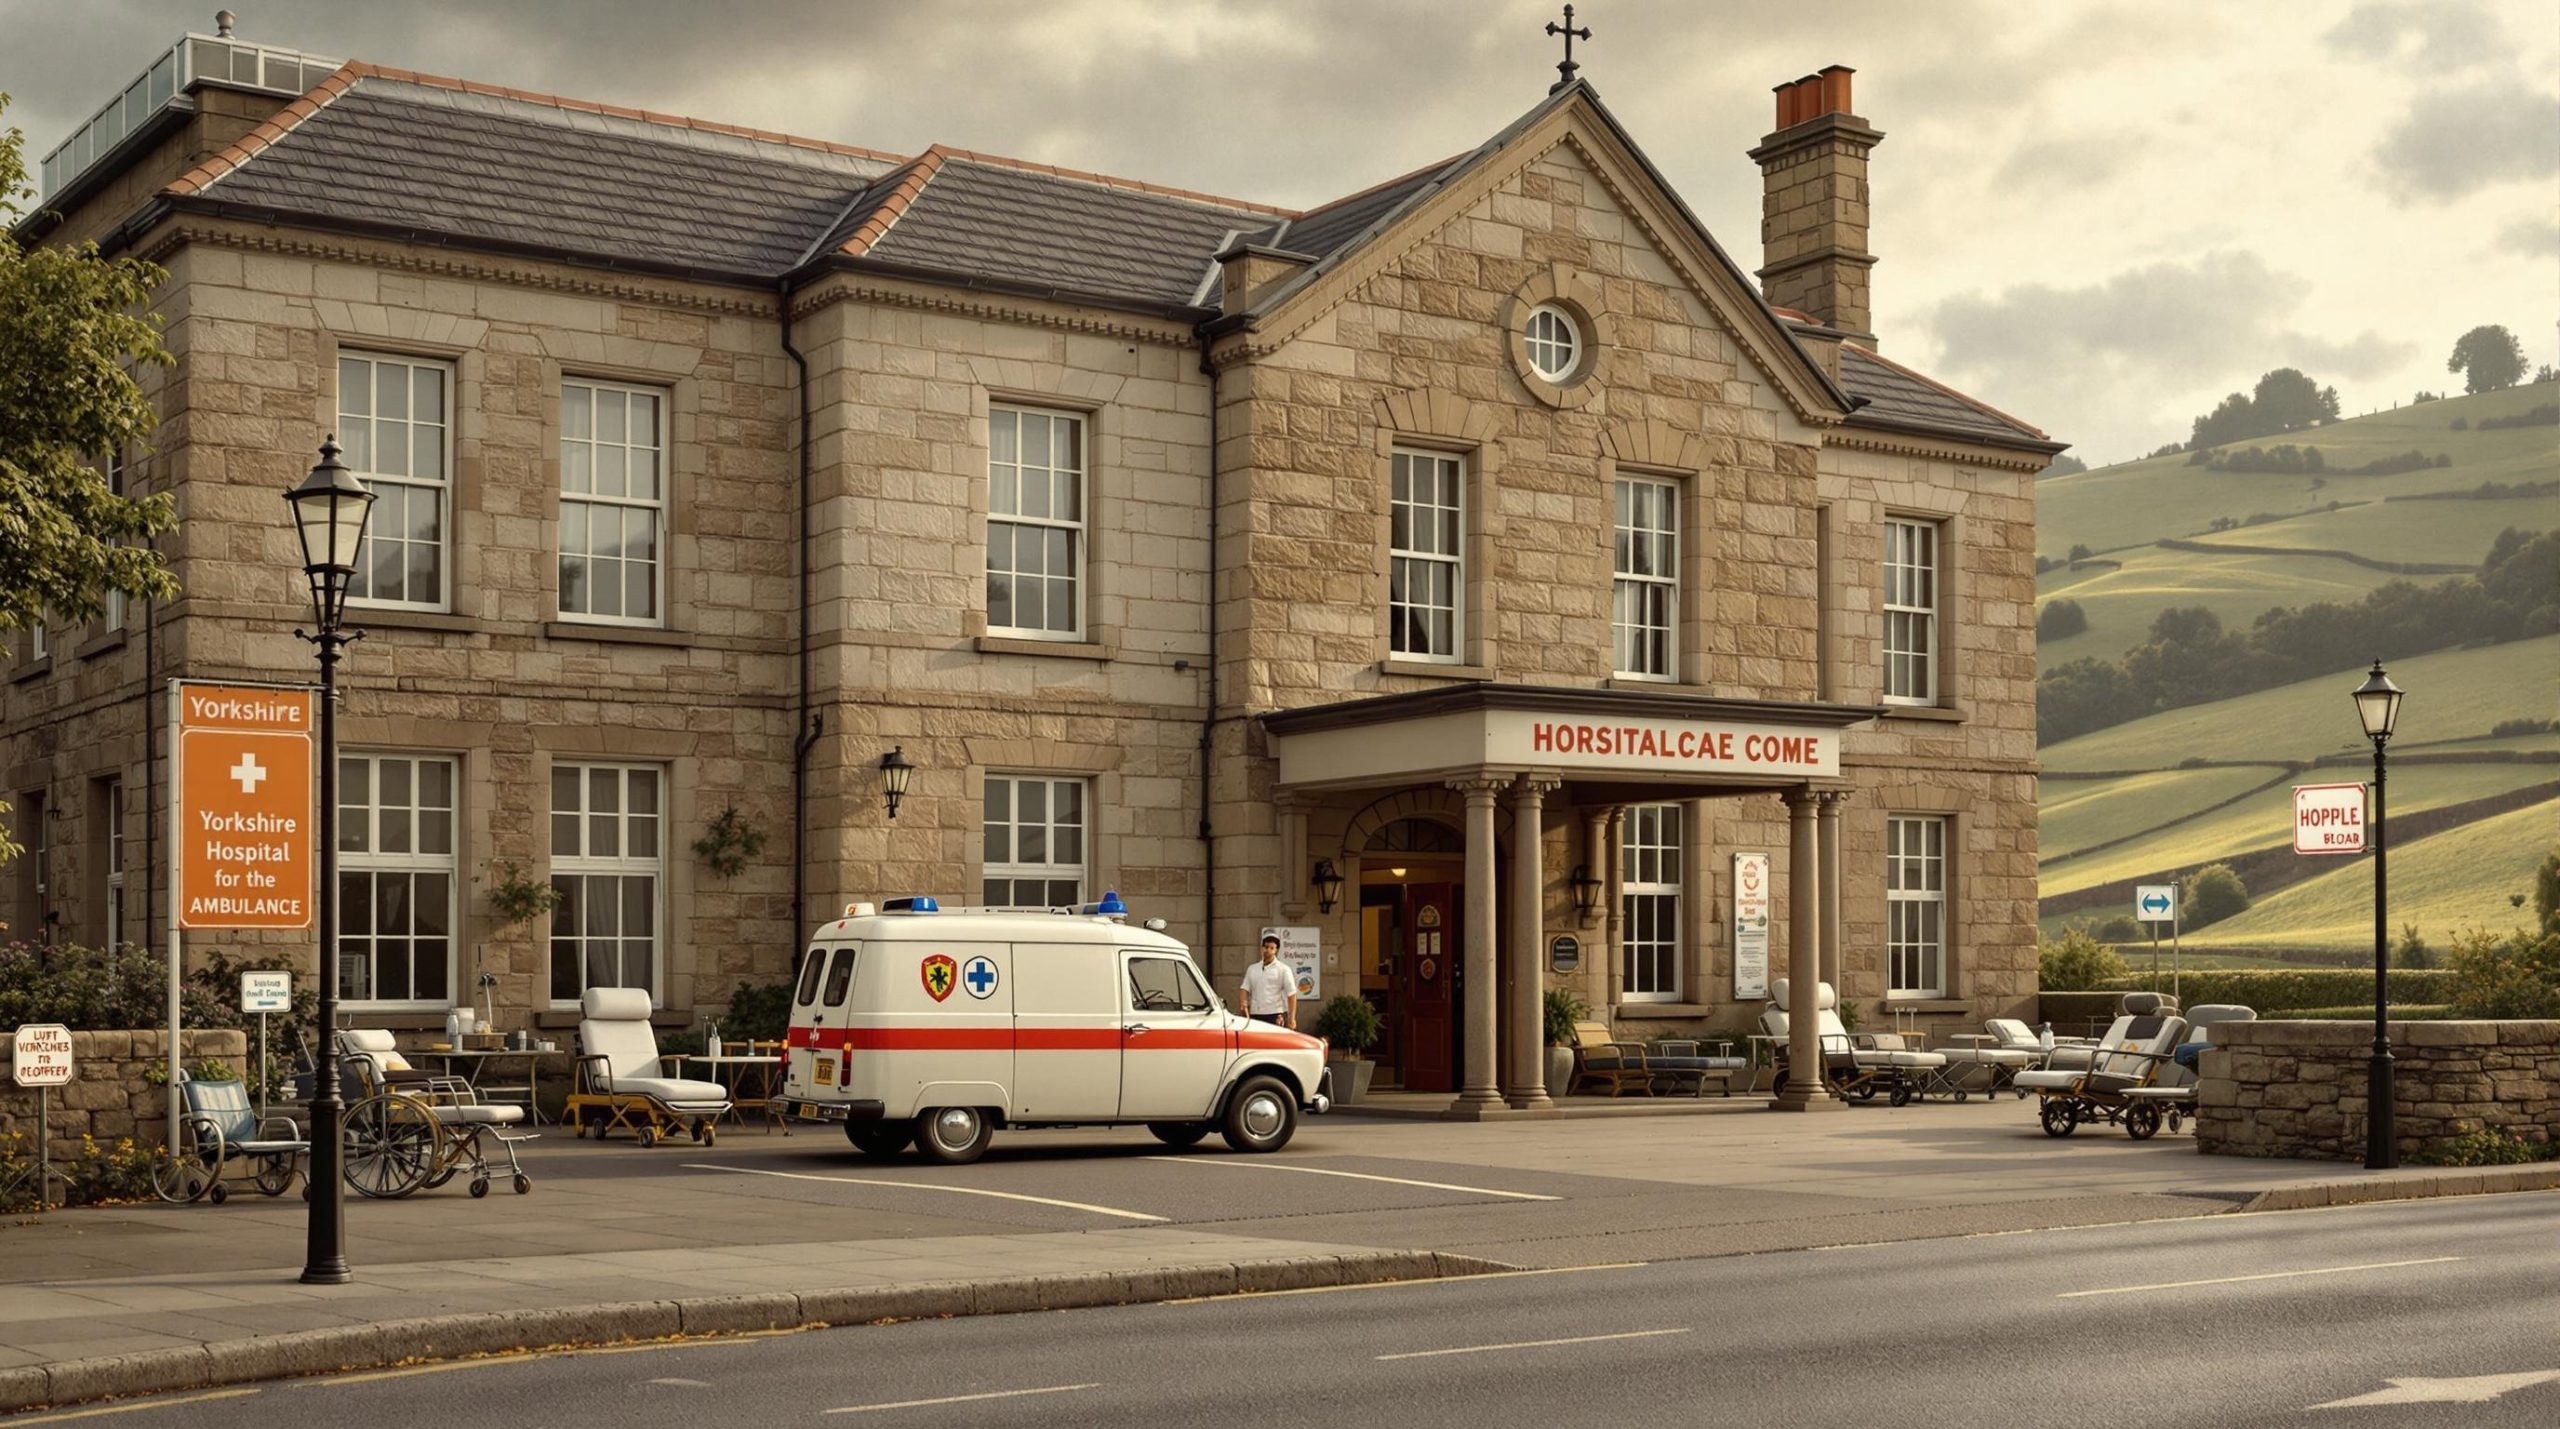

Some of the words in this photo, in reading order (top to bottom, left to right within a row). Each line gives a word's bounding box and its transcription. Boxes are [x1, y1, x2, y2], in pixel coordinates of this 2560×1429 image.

[190, 695, 301, 722] Yorkshire
[1533, 723, 1734, 759] HORSITALCAE
[1745, 734, 1819, 764] COME
[200, 810, 297, 833] Yorkshire
[2300, 807, 2361, 827] HOPPLE
[206, 840, 291, 866] Hospital
[214, 868, 240, 887] for
[246, 870, 277, 888] the
[189, 897, 302, 916] AMBULANCE
